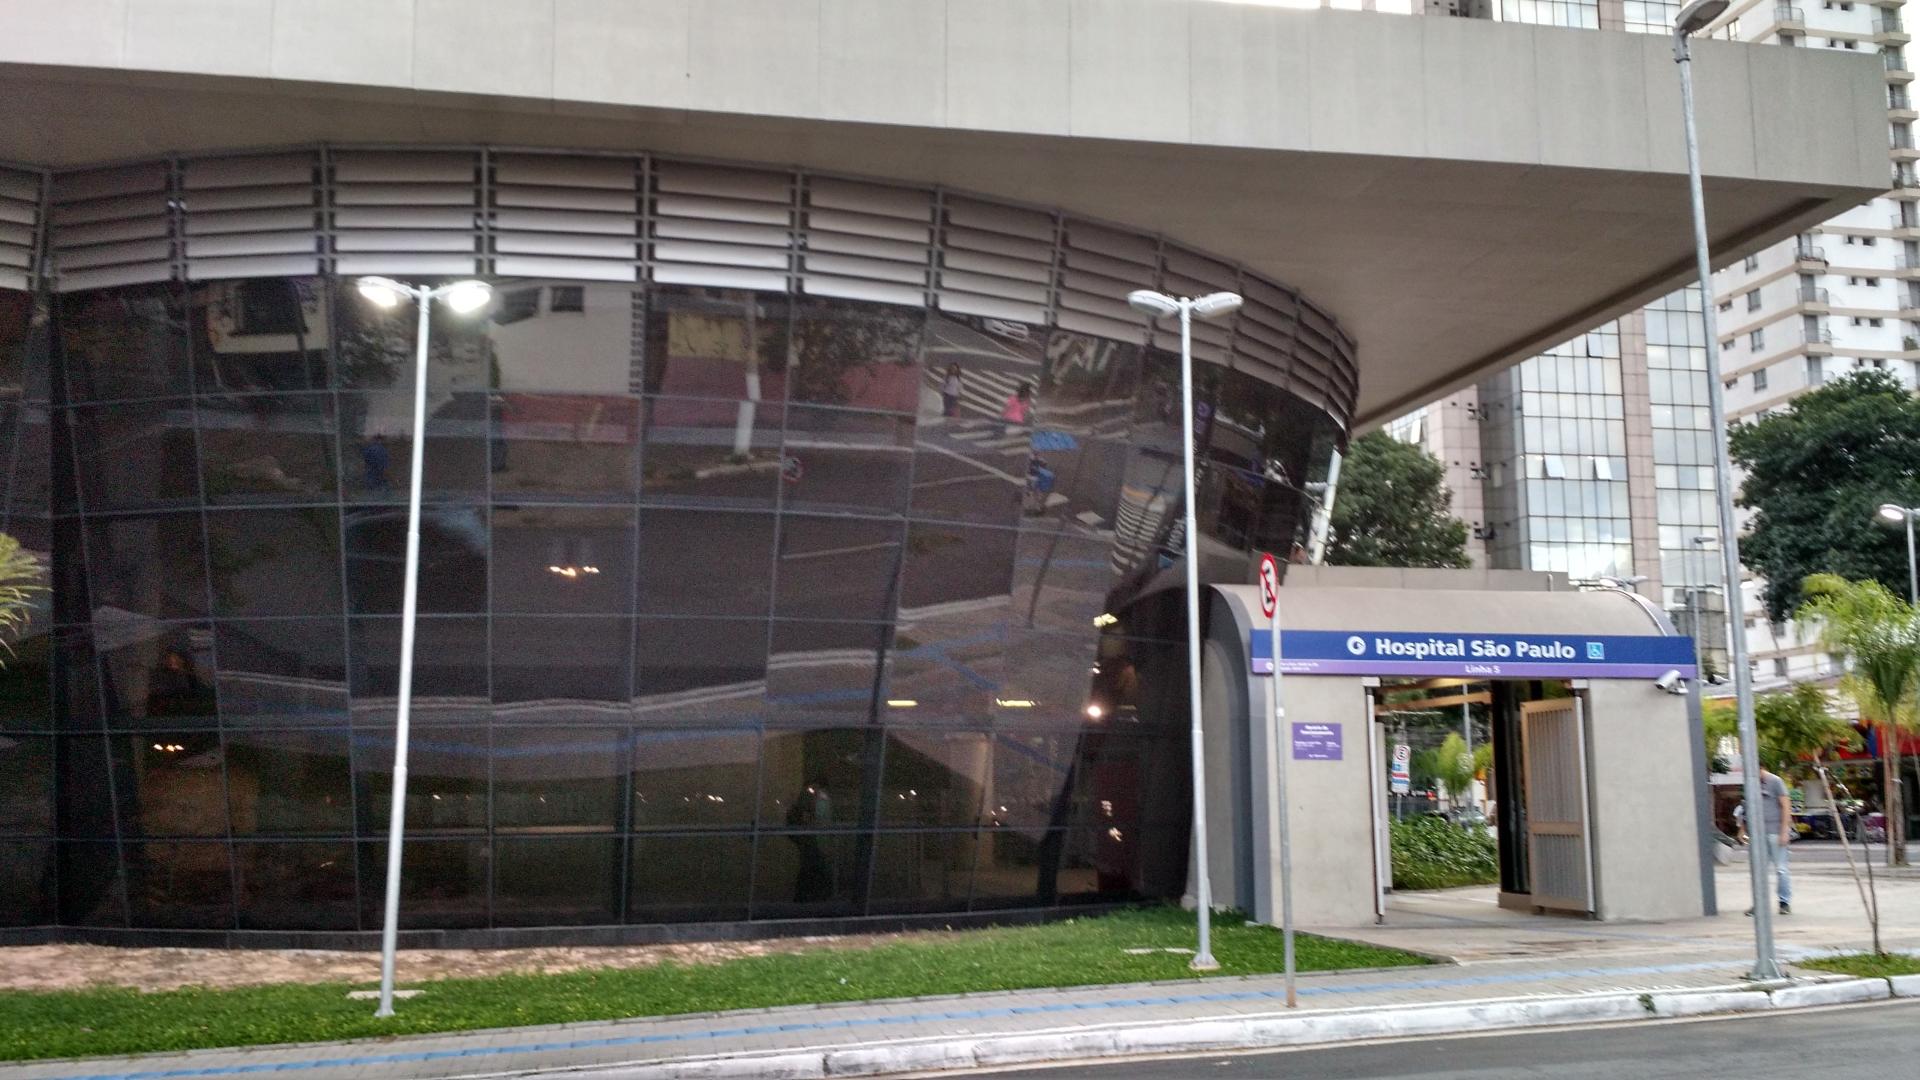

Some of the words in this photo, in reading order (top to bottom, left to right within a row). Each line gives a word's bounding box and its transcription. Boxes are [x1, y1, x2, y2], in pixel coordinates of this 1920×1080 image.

[1375, 638, 1466, 660] Hospital
[1470, 640, 1511, 657] São
[1515, 641, 1576, 659] Paulo
[1464, 664, 1492, 674] Linha
